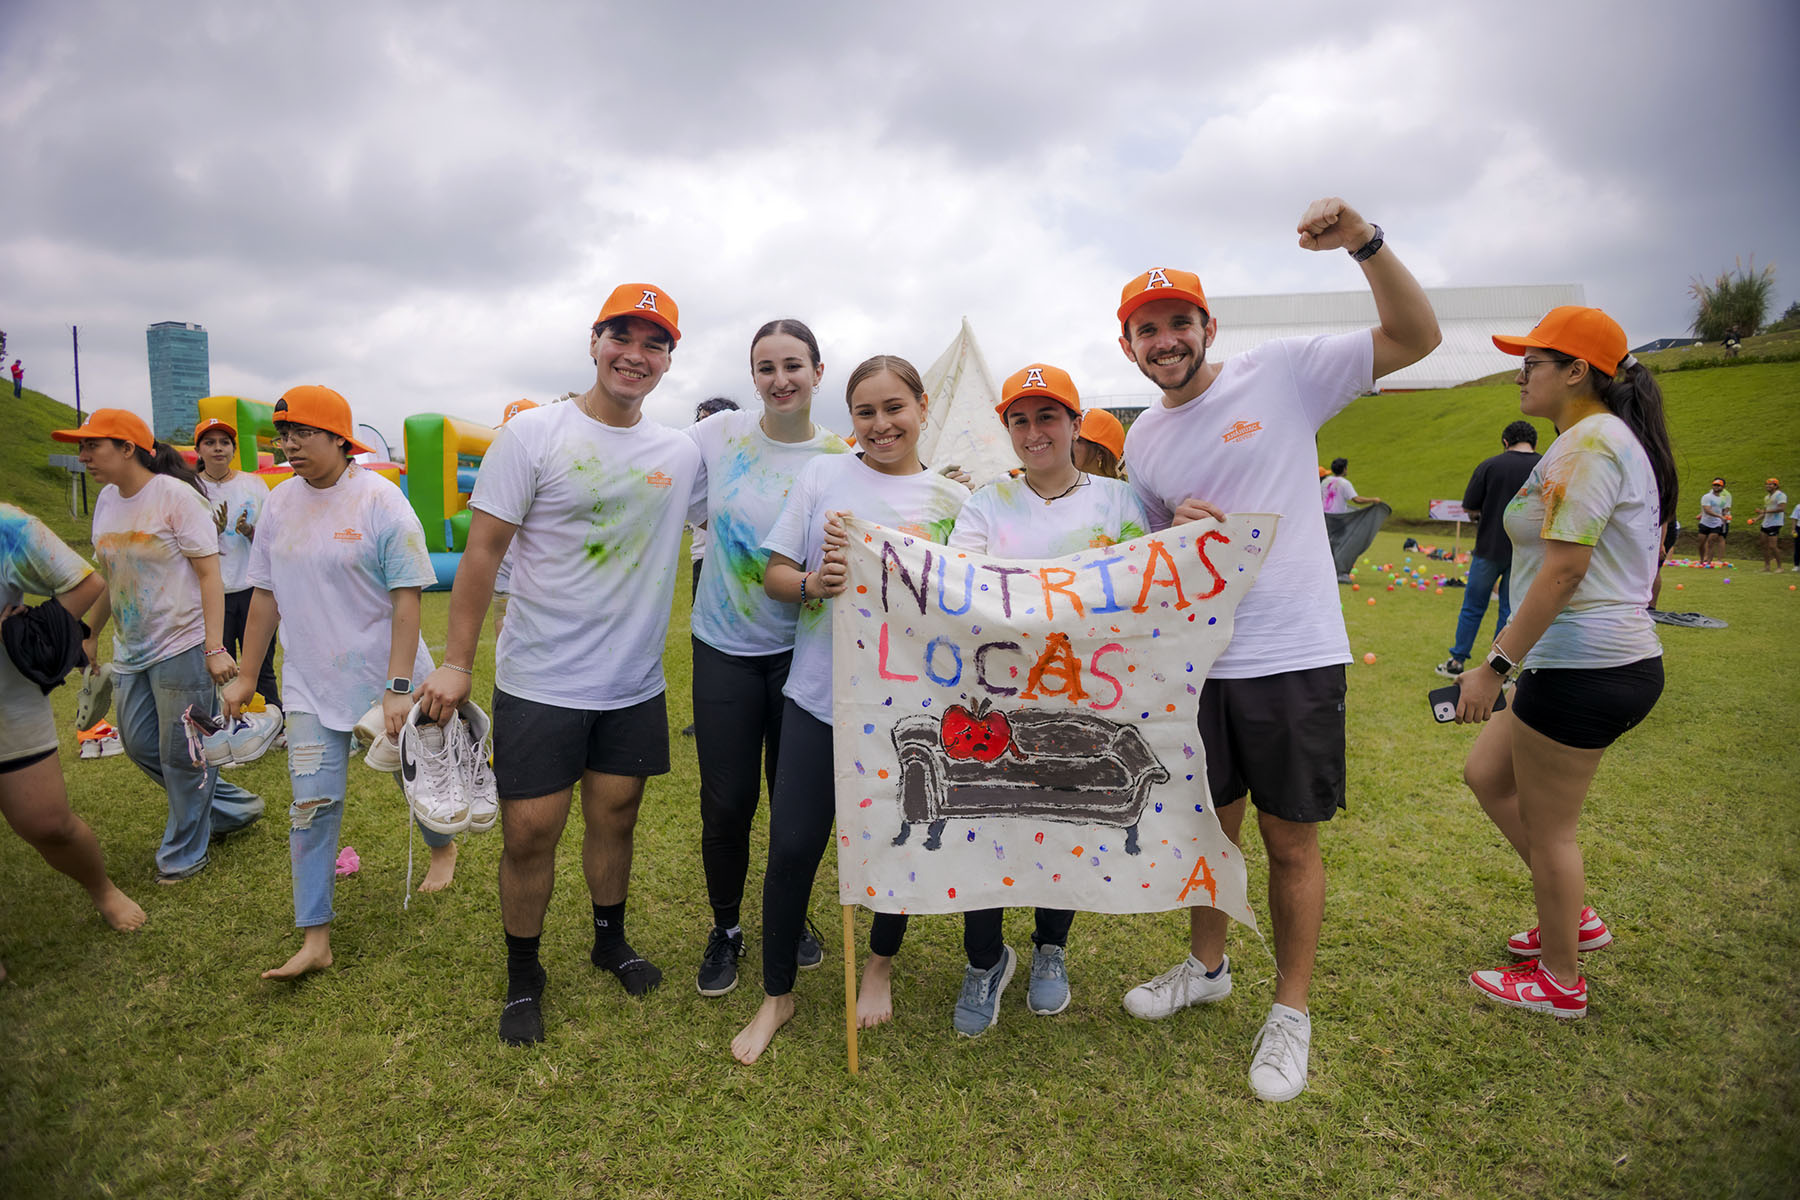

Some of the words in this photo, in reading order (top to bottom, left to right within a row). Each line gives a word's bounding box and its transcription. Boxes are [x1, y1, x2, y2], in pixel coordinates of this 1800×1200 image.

[1144, 269, 1173, 291] A
[635, 290, 658, 312] A
[1022, 368, 1047, 388] A
[880, 529, 1232, 621] NUTRIAS
[877, 622, 1125, 711] LOCAS
[1175, 855, 1217, 907] A
